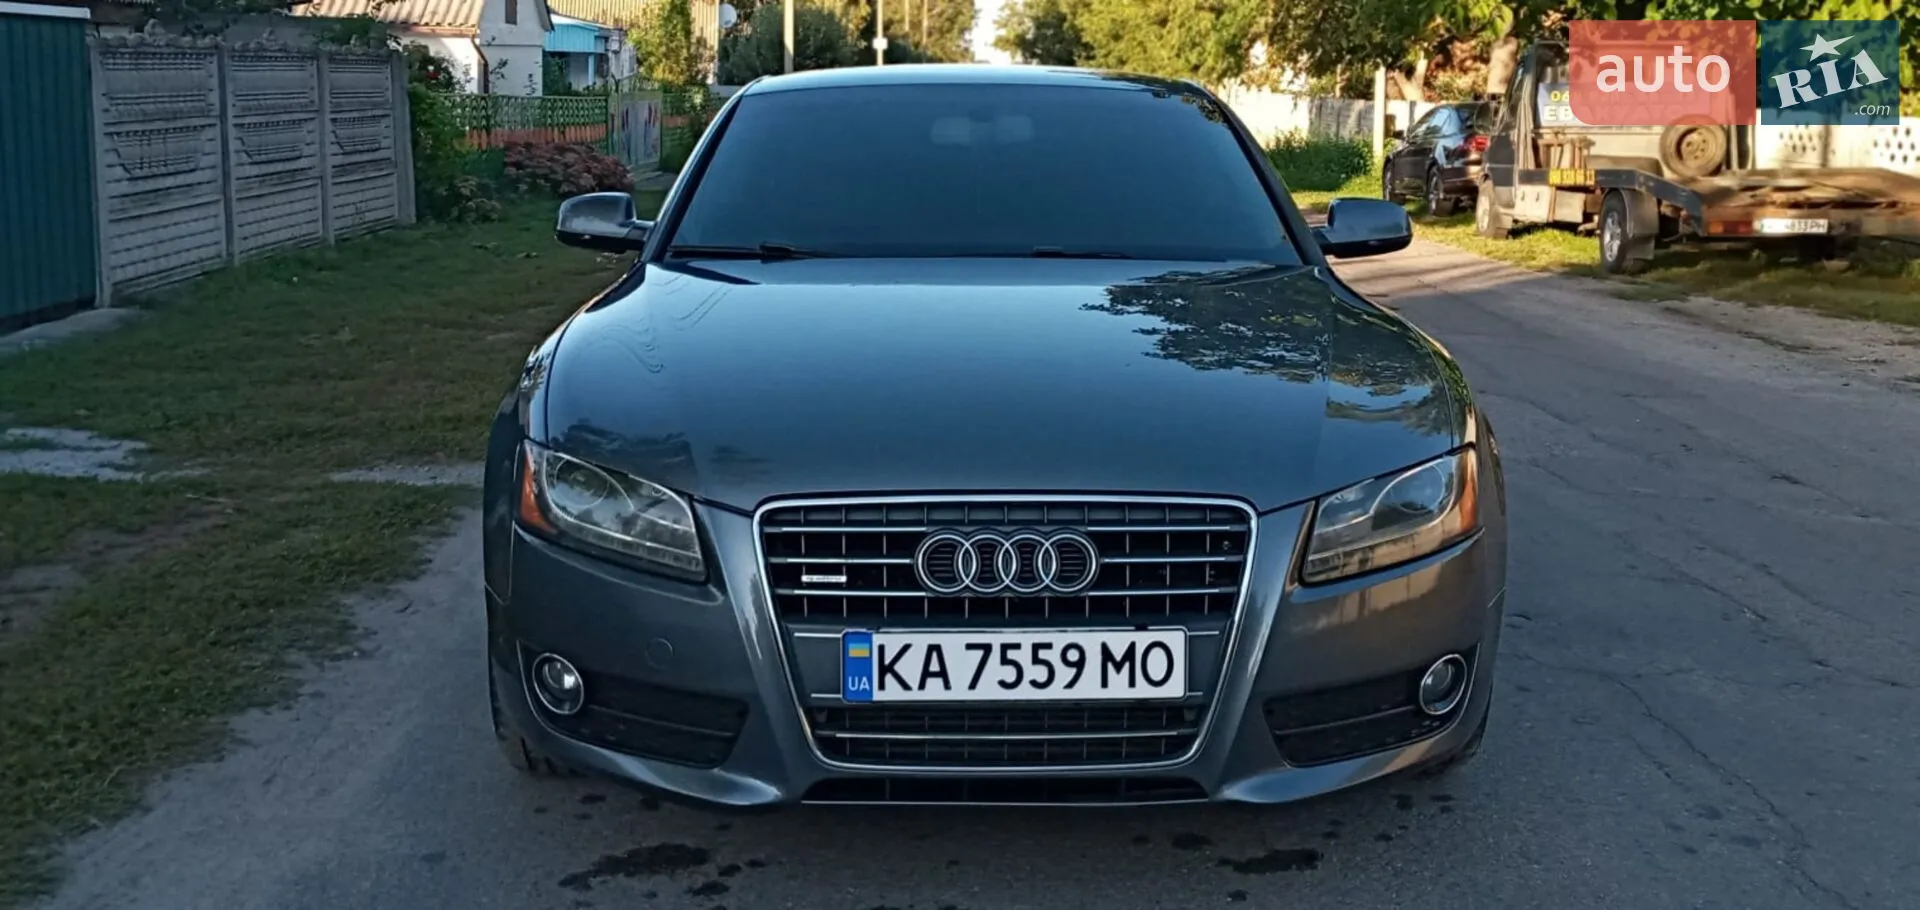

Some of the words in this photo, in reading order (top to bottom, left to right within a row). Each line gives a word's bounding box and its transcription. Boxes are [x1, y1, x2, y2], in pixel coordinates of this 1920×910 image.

[877, 643, 952, 691] KA
[965, 642, 1087, 690] 7559
[1101, 640, 1175, 689] MO
[848, 676, 870, 691] UA
